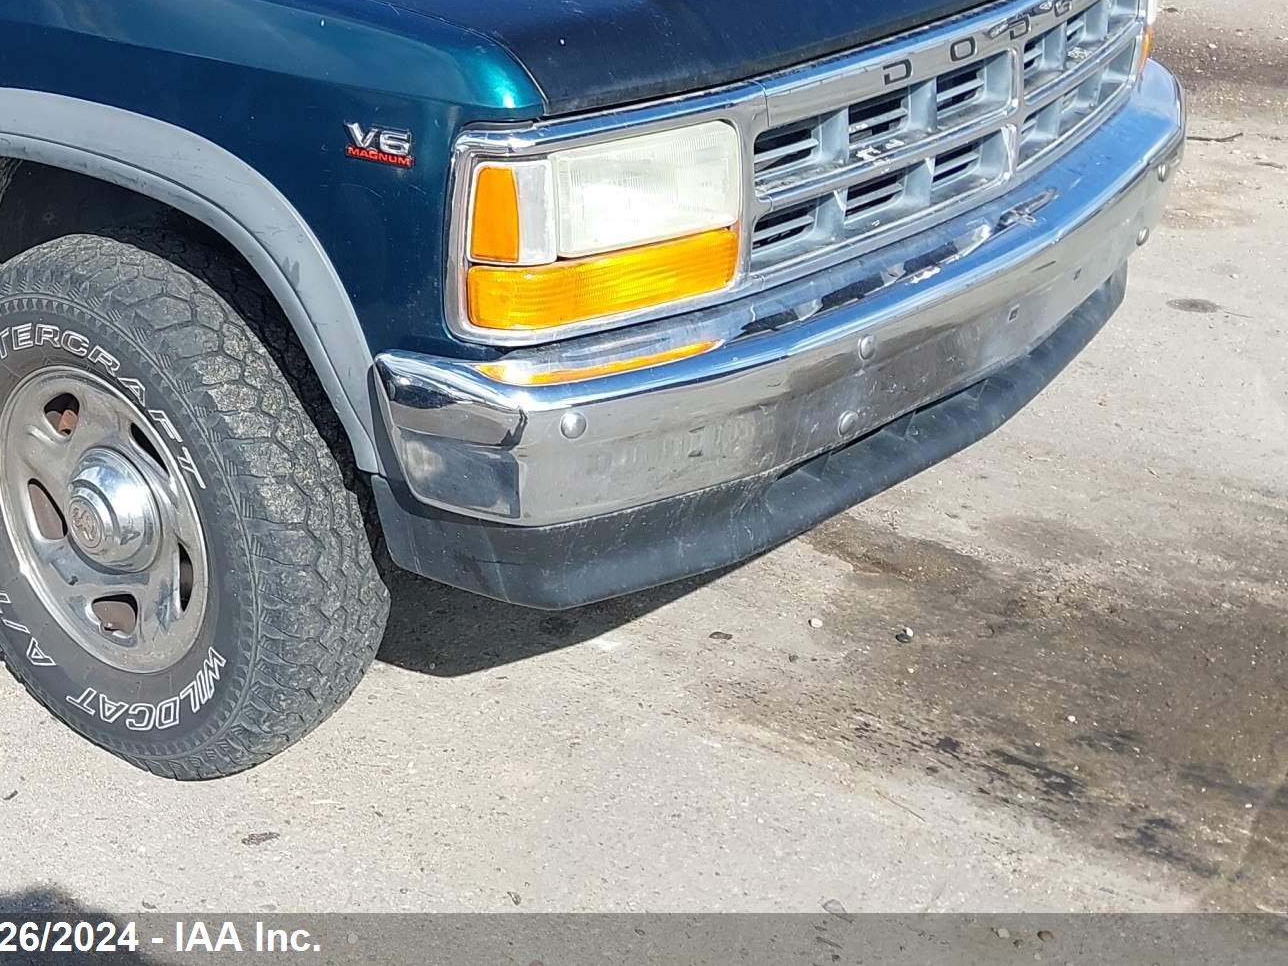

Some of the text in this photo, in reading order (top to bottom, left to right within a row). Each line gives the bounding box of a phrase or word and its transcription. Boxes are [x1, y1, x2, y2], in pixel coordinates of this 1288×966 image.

[344, 121, 411, 156] V6
[346, 146, 412, 166] MAGNUM
[66, 646, 227, 732] WILDCAT
